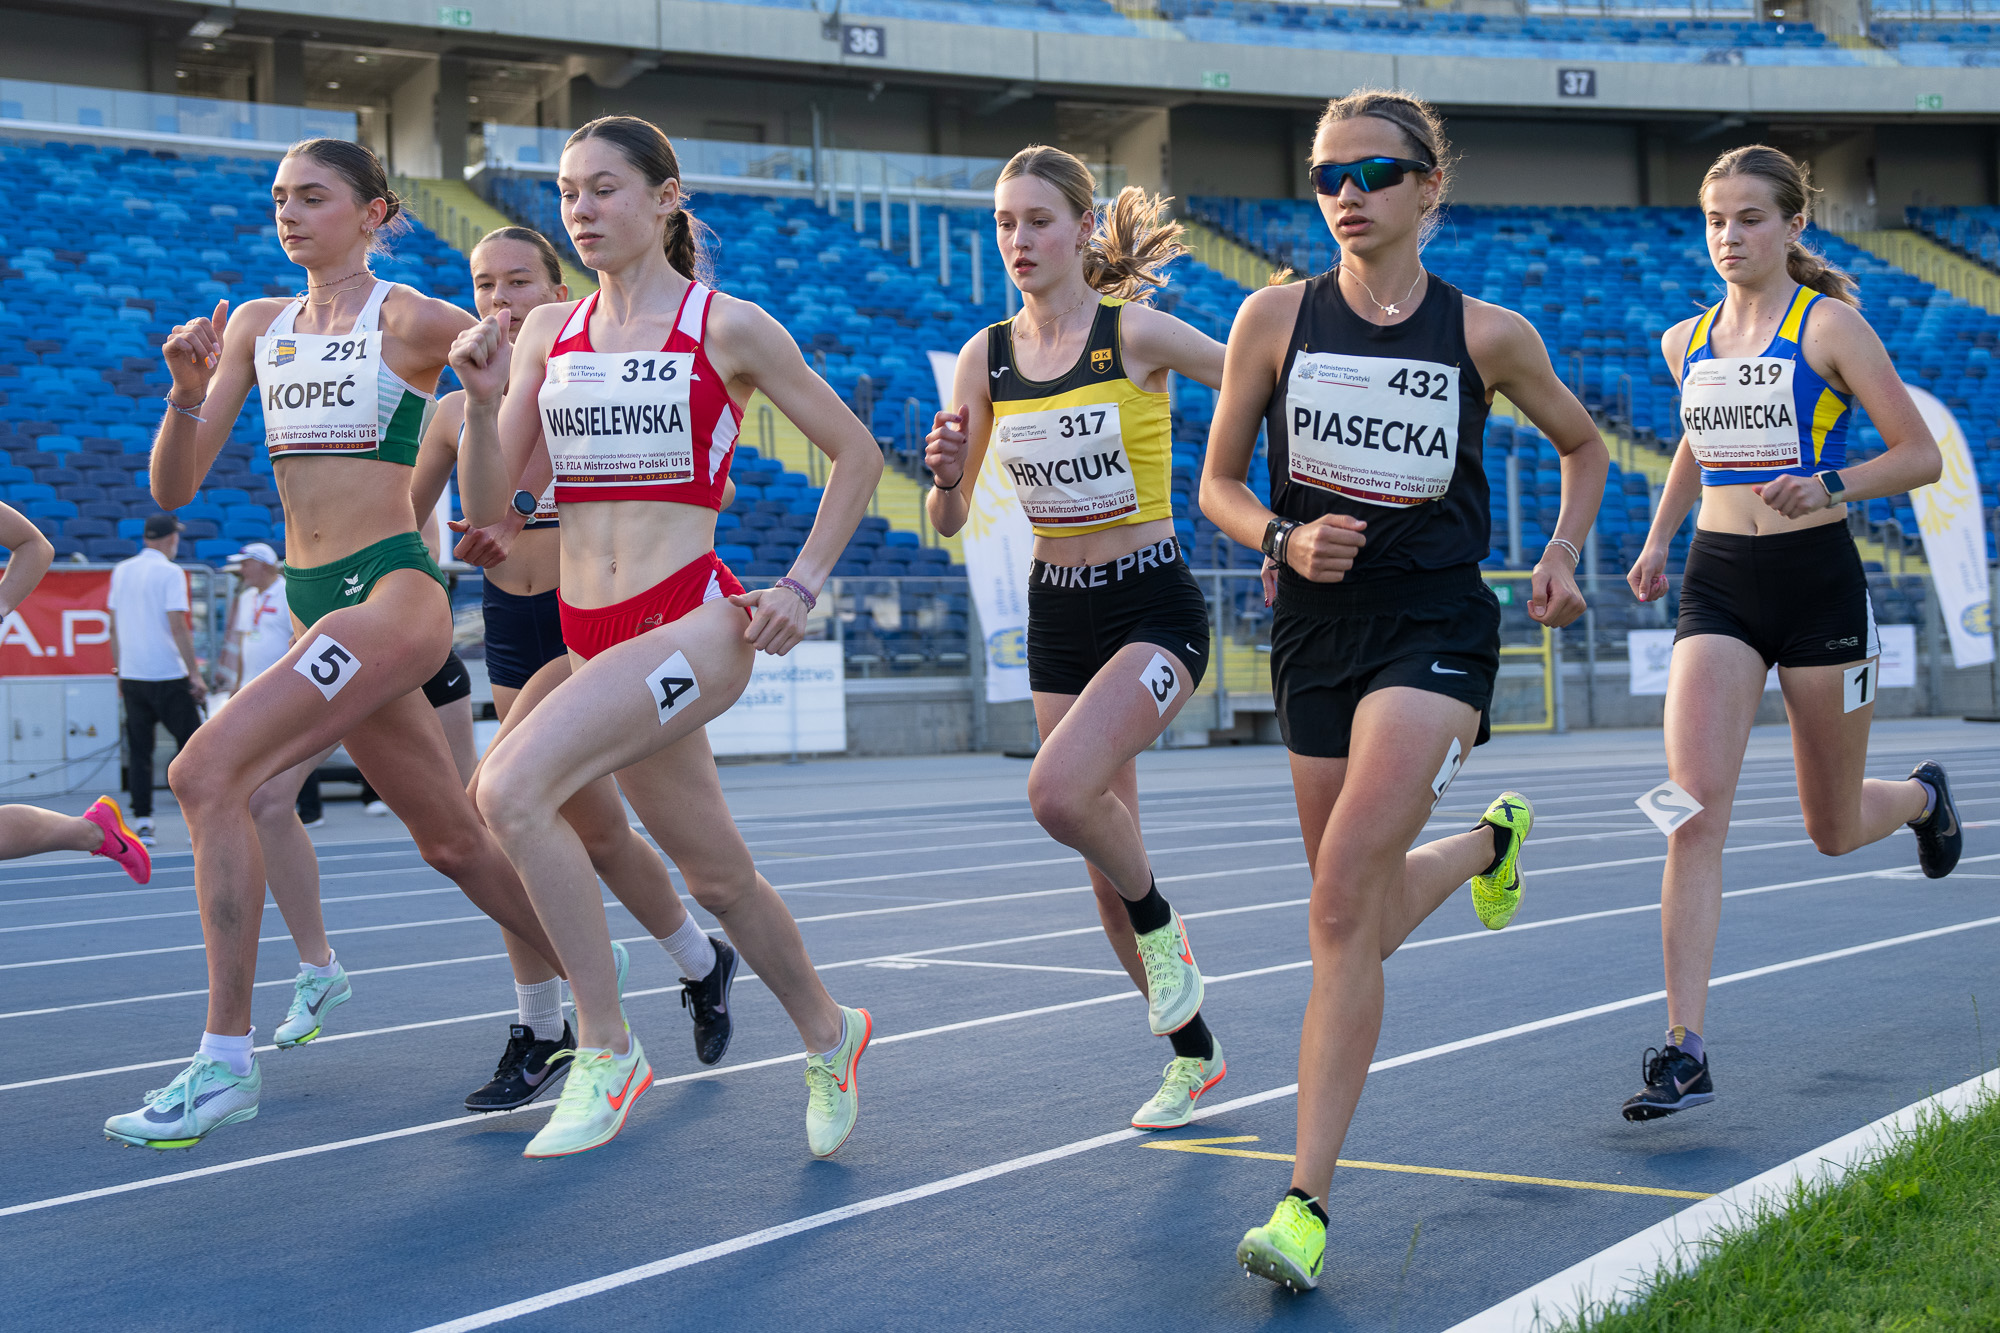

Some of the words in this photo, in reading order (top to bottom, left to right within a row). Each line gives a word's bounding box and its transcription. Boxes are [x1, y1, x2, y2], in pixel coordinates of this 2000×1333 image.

[850, 27, 879, 54] 36
[1564, 71, 1590, 95] 37
[320, 338, 367, 362] 291
[621, 358, 677, 383] 316
[1098, 362, 1105, 370] S
[1317, 370, 1339, 378] Sportu
[1343, 373, 1371, 382] Turystyki
[1319, 364, 1359, 374] Ministerstwo
[1738, 363, 1782, 386] 319
[268, 374, 356, 411] KOPEĆ
[1387, 368, 1449, 401] 432
[287, 423, 310, 431] Olimpiada
[545, 404, 684, 437] WASIELEWSKA
[1058, 410, 1106, 438] 317
[1684, 403, 1793, 436] RĘKAWIECKA
[268, 433, 280, 441] PZLA
[280, 430, 328, 440] Mistrzostwa
[330, 430, 357, 438] Polski
[359, 429, 377, 438] U18
[1294, 406, 1449, 460] PIASECKA
[555, 461, 566, 470] 55.
[566, 461, 582, 470] PZLA
[583, 459, 636, 470] Mistrzostwa
[639, 458, 669, 469] Polski
[671, 457, 691, 467] U18
[589, 453, 617, 461] Olimpiada
[618, 452, 642, 460] Młodzieży
[648, 451, 666, 459] lekkiej
[1713, 449, 1754, 458] Mistrzostwa
[1756, 448, 1779, 457] Polski
[1781, 446, 1798, 455] U18
[629, 472, 678, 481] 7-9.07.2022
[1008, 449, 1127, 487] HRYCIUK
[1290, 458, 1304, 470] 55.
[1306, 463, 1328, 477] PZLA
[1330, 470, 1391, 489] Mistrzostwa
[1394, 480, 1425, 493] Polski
[1427, 484, 1446, 493] U18
[1301, 455, 1338, 468] Ogólnopolska
[1338, 464, 1369, 474] Olimpiada
[1369, 469, 1399, 480] Młodzieży
[1406, 474, 1425, 483] lekkiej
[1306, 477, 1342, 492] CHORZÓW
[1031, 505, 1048, 514] PZLA
[1048, 503, 1090, 514] Mistrzostwa
[1091, 498, 1118, 510] Polski
[1118, 493, 1135, 504] U18
[1085, 508, 1126, 521] 7-9.07.2022
[1040, 562, 1108, 589] NIKE
[1115, 538, 1177, 582] PRO
[310, 643, 352, 686] 5
[659, 676, 695, 710] 4
[1151, 665, 1175, 703] 3
[1854, 666, 1869, 704] 1
